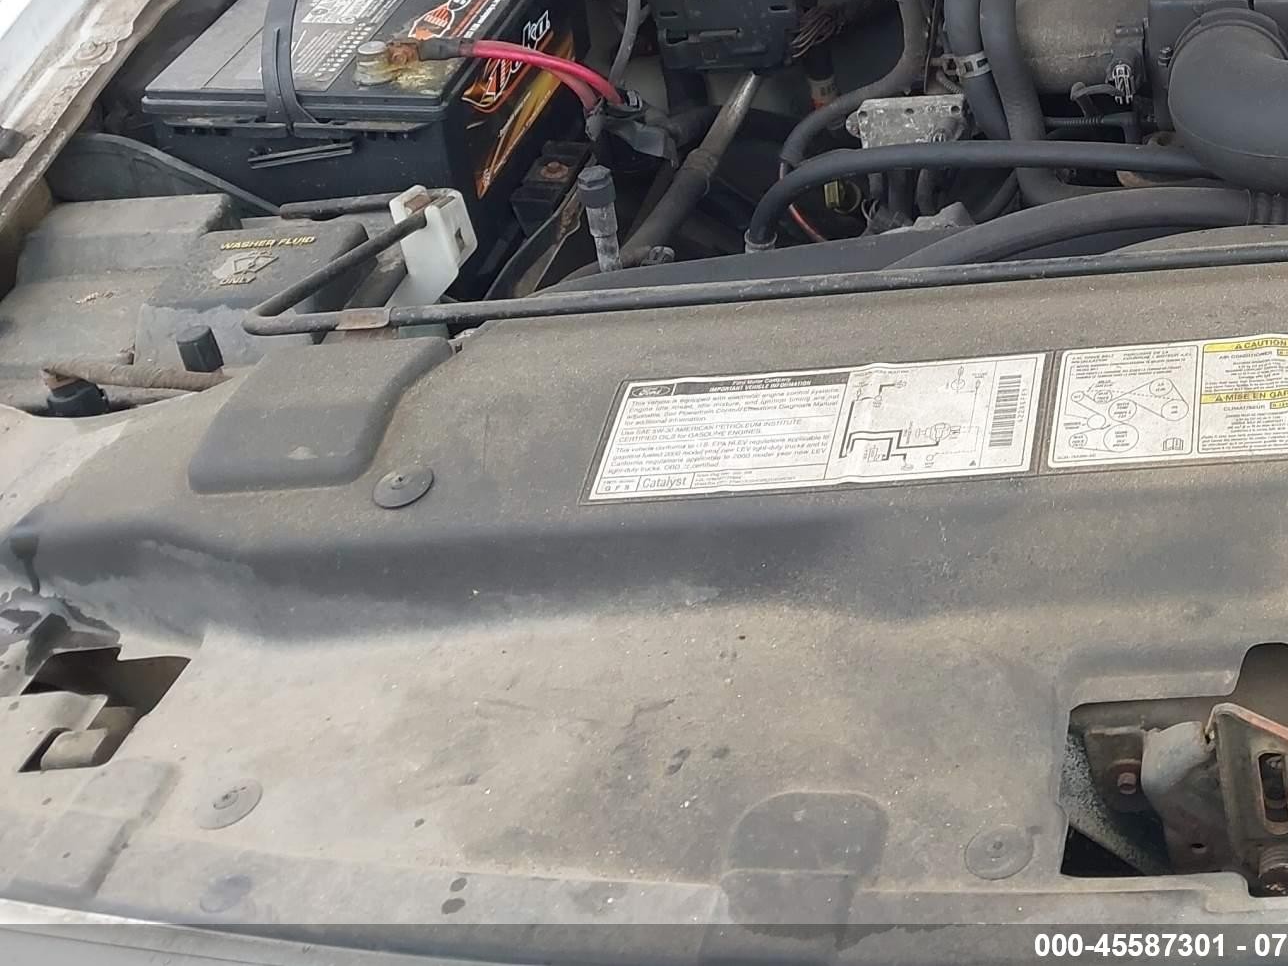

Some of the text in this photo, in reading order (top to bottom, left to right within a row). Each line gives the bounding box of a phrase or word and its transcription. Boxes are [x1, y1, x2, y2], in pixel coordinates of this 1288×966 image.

[220, 236, 317, 250] WASHER FLUID
[220, 276, 256, 286] ONLY
[1244, 339, 1287, 350] CAUTION
[709, 384, 744, 392] IMPORTANT
[1225, 393, 1250, 402] MISE
[1253, 392, 1266, 400] EN
[674, 425, 714, 433] AMERICAN
[763, 419, 802, 427] INSTITUTE
[642, 476, 687, 490] Catalyst
